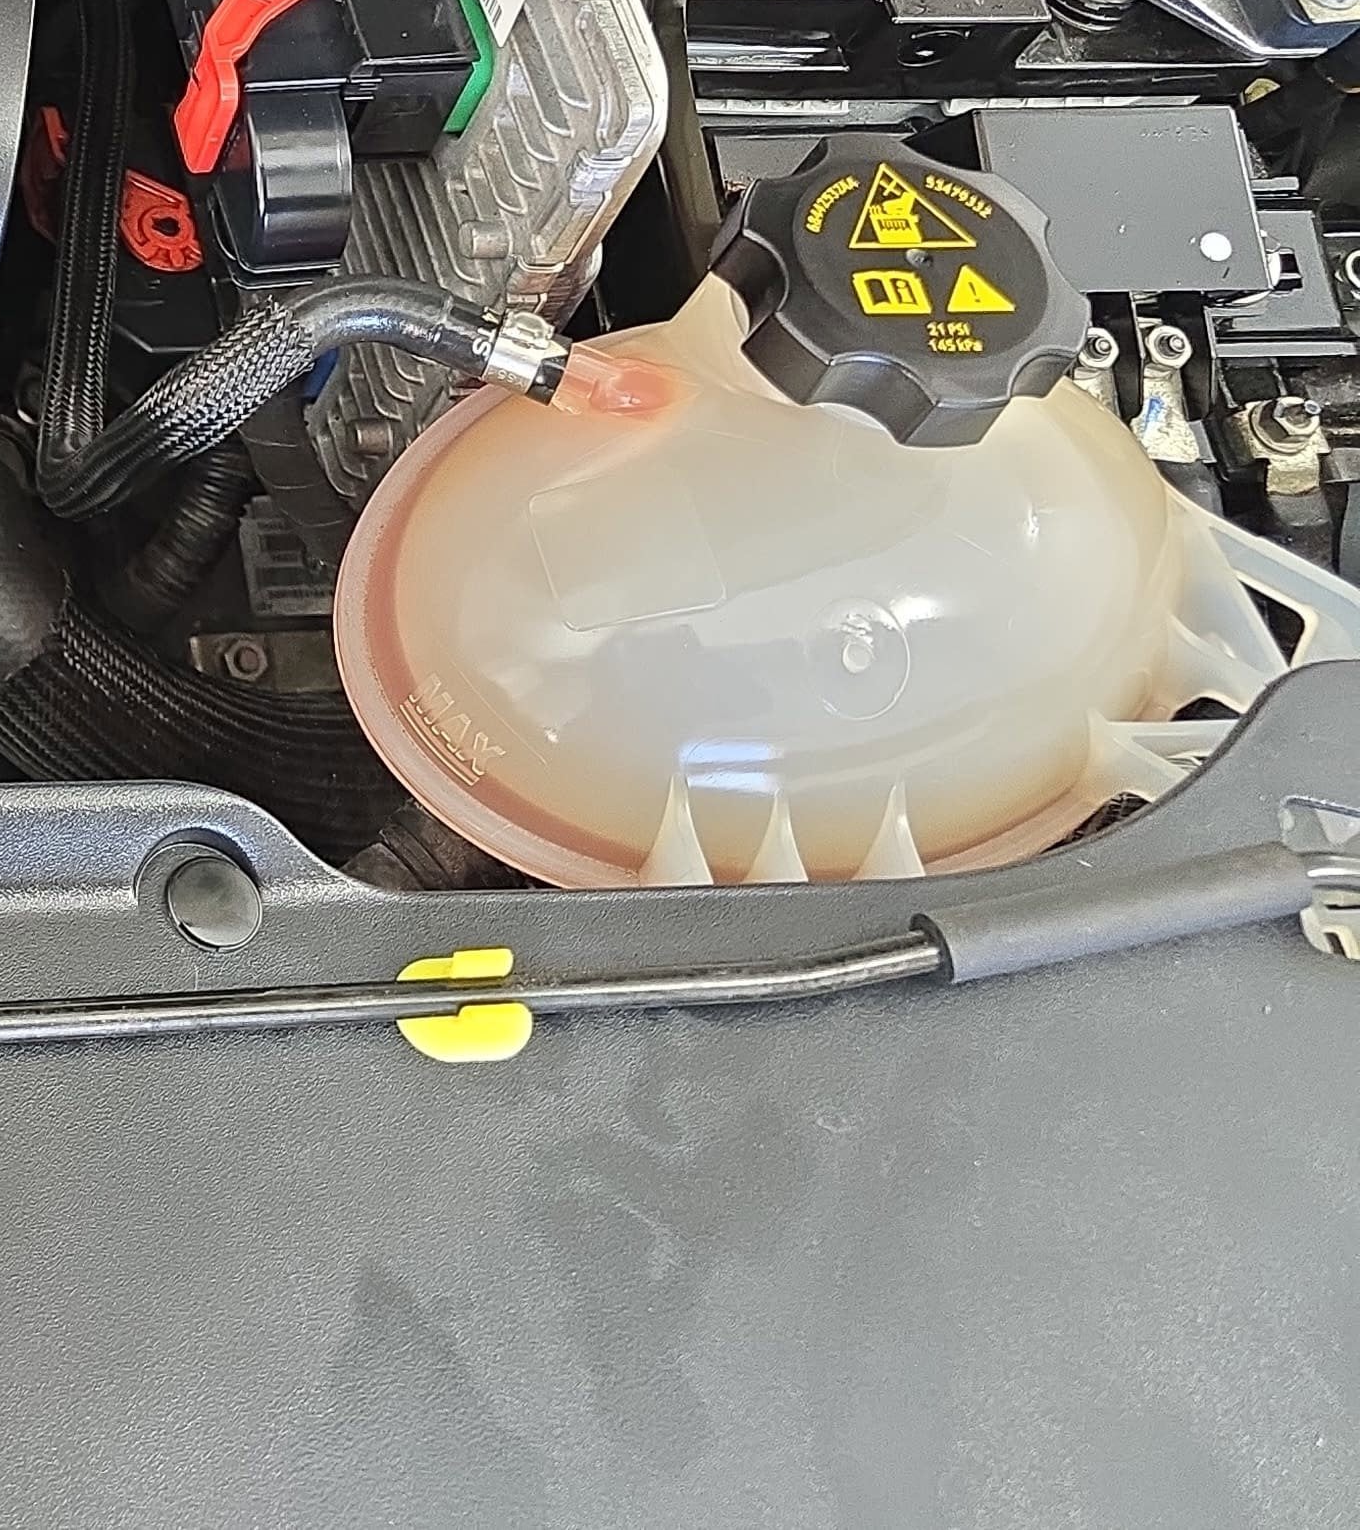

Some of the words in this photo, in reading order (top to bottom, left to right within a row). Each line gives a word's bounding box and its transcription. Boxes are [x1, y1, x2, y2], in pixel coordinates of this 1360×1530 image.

[927, 321, 946, 337] 21
[947, 321, 971, 337] PSI
[928, 337, 956, 352] 145
[408, 673, 507, 776] MAX
